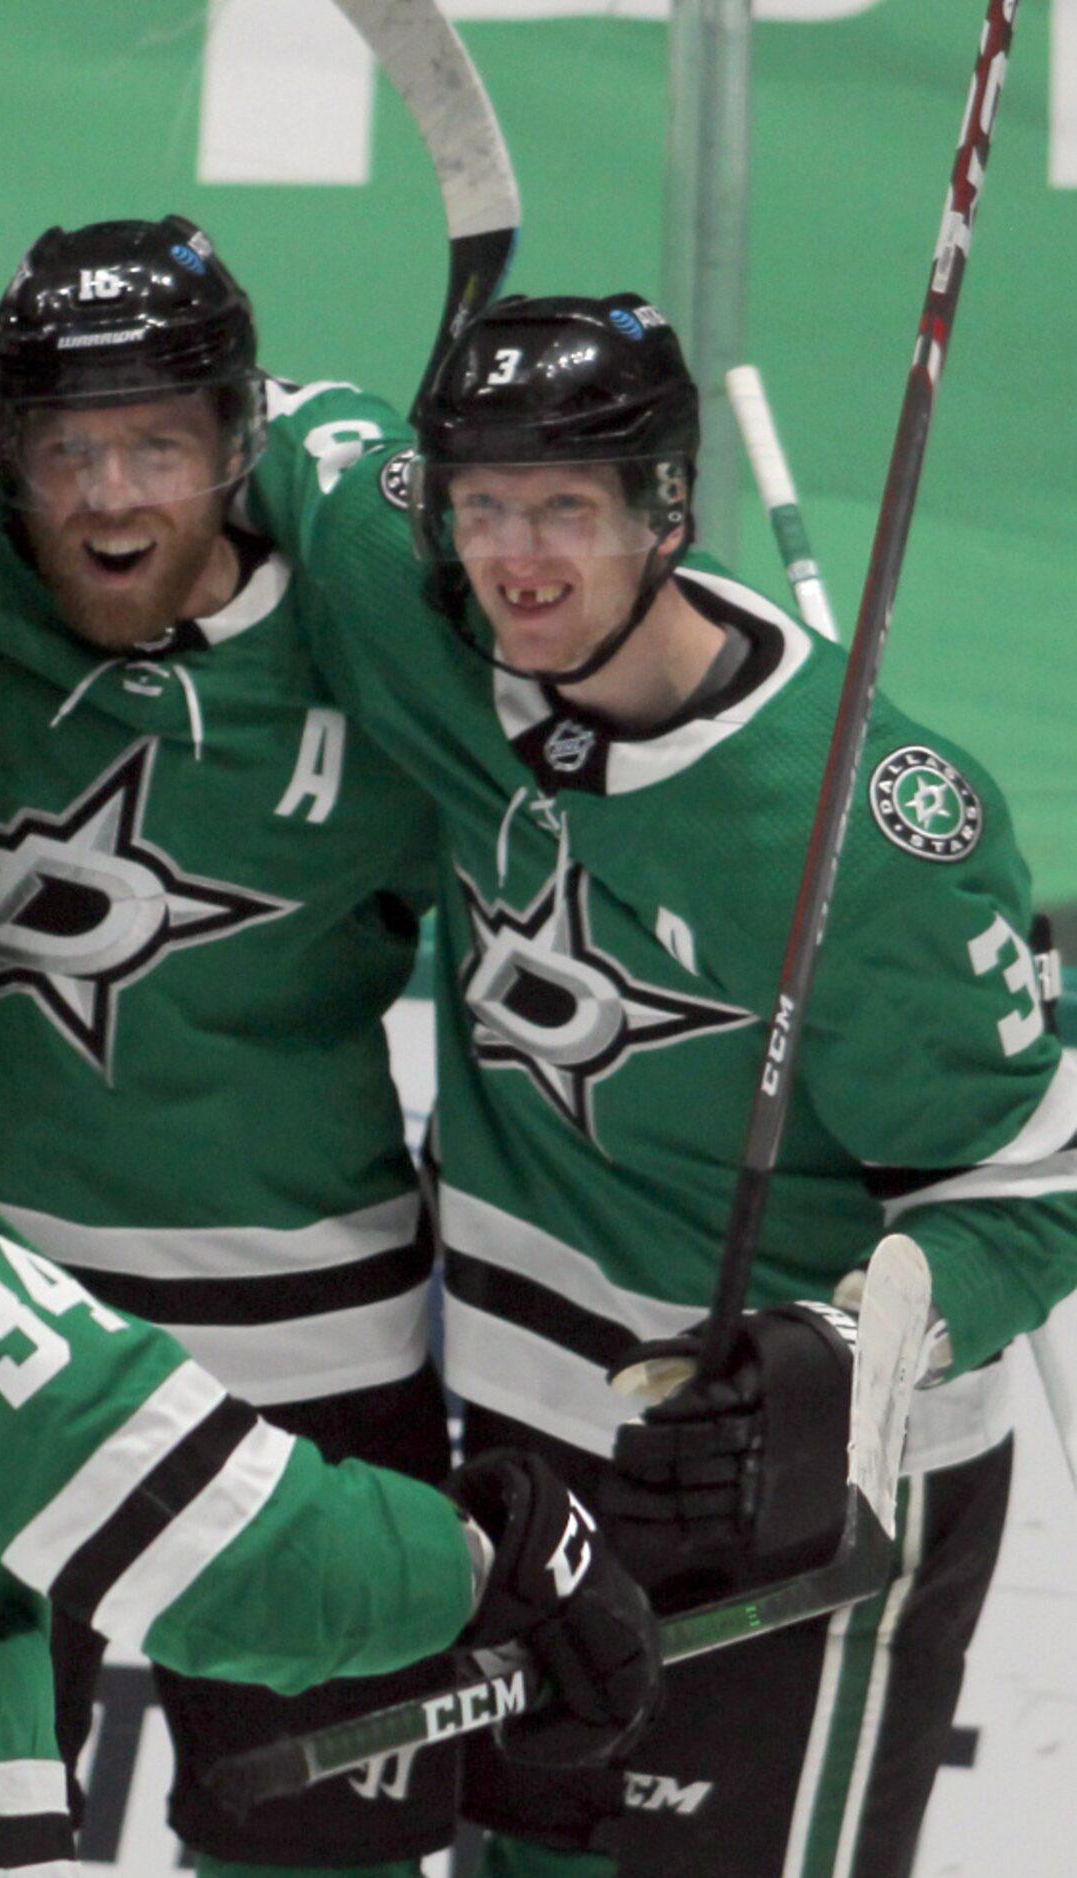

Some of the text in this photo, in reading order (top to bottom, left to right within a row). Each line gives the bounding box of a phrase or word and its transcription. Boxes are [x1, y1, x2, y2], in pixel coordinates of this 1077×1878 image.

[488, 349, 522, 385] 3
[273, 707, 347, 825] A
[878, 753, 957, 815] DALLAS
[966, 911, 1044, 1058] 3
[761, 993, 794, 1096] CCM
[422, 1669, 527, 1743] CCM
